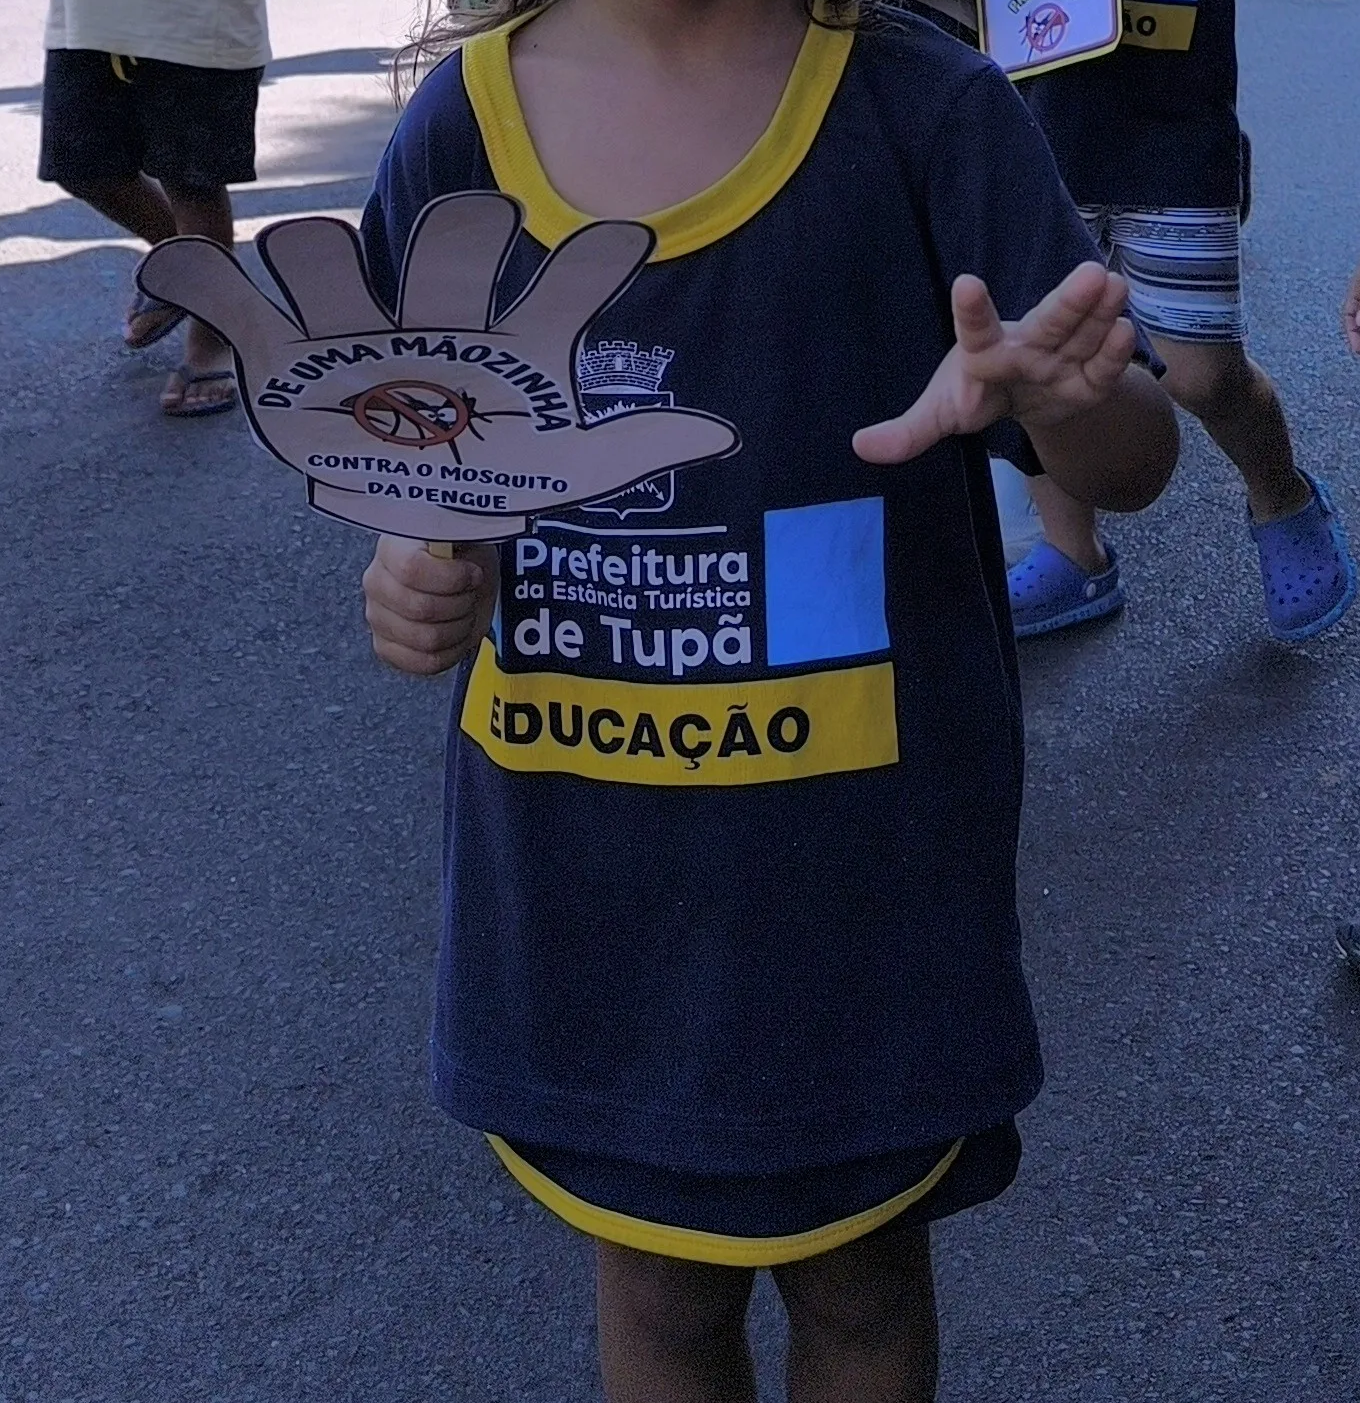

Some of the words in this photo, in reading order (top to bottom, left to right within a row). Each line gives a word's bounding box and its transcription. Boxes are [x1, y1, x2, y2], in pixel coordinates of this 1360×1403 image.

[257, 377, 305, 409] DE
[290, 344, 383, 380] UMA
[390, 335, 572, 432] MÃOZINHA
[307, 454, 410, 476] CONTRA
[416, 463, 433, 477] O
[440, 465, 568, 493] MOSQUITO
[367, 481, 402, 498] DA
[408, 485, 508, 510] DENGUE
[515, 538, 749, 587] Prefeitura
[514, 580, 544, 600] da
[552, 581, 638, 611] Estância
[643, 587, 751, 611] Turística
[513, 608, 585, 659] de
[599, 613, 752, 677] Tupã
[490, 692, 811, 771] EDUCAÇÃO
